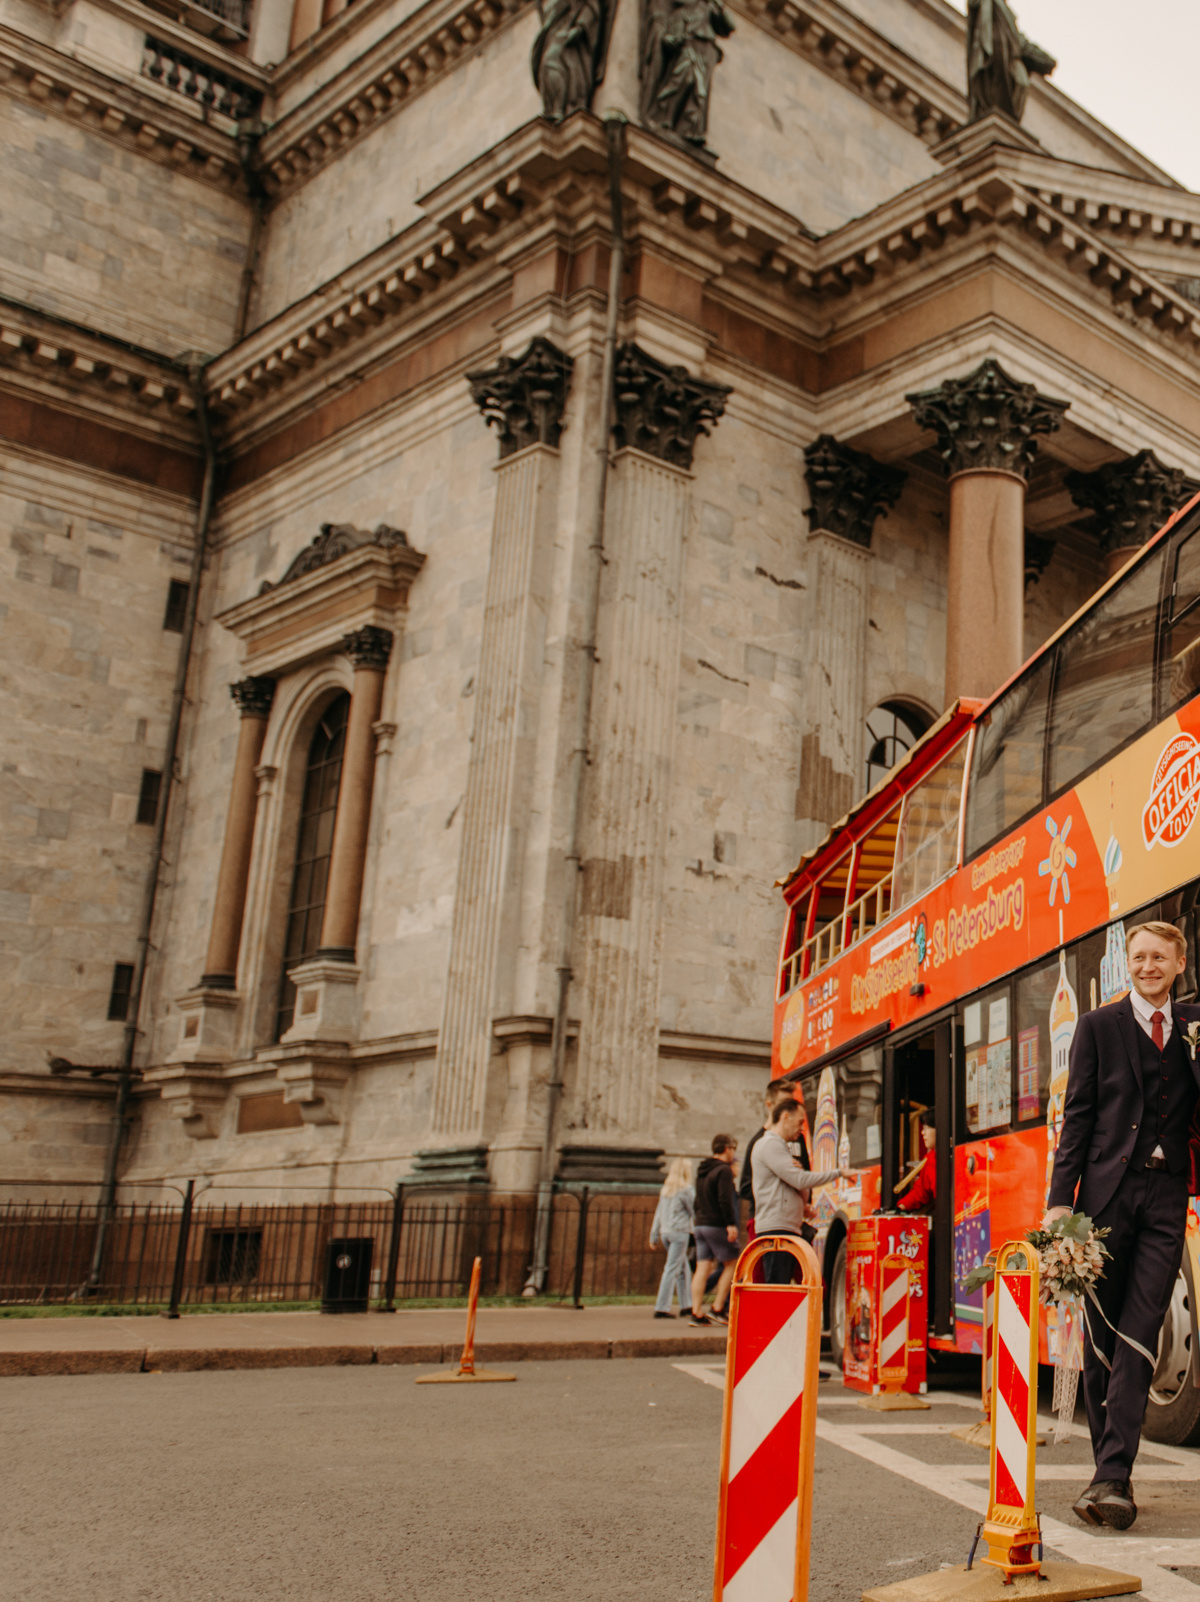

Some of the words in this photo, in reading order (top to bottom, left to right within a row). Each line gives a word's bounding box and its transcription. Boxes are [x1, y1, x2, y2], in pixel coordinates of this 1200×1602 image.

[1169, 796, 1197, 838] TOUR
[933, 919, 947, 967] St
[948, 878, 1024, 959] Petersburg
[897, 1244, 919, 1259] day
